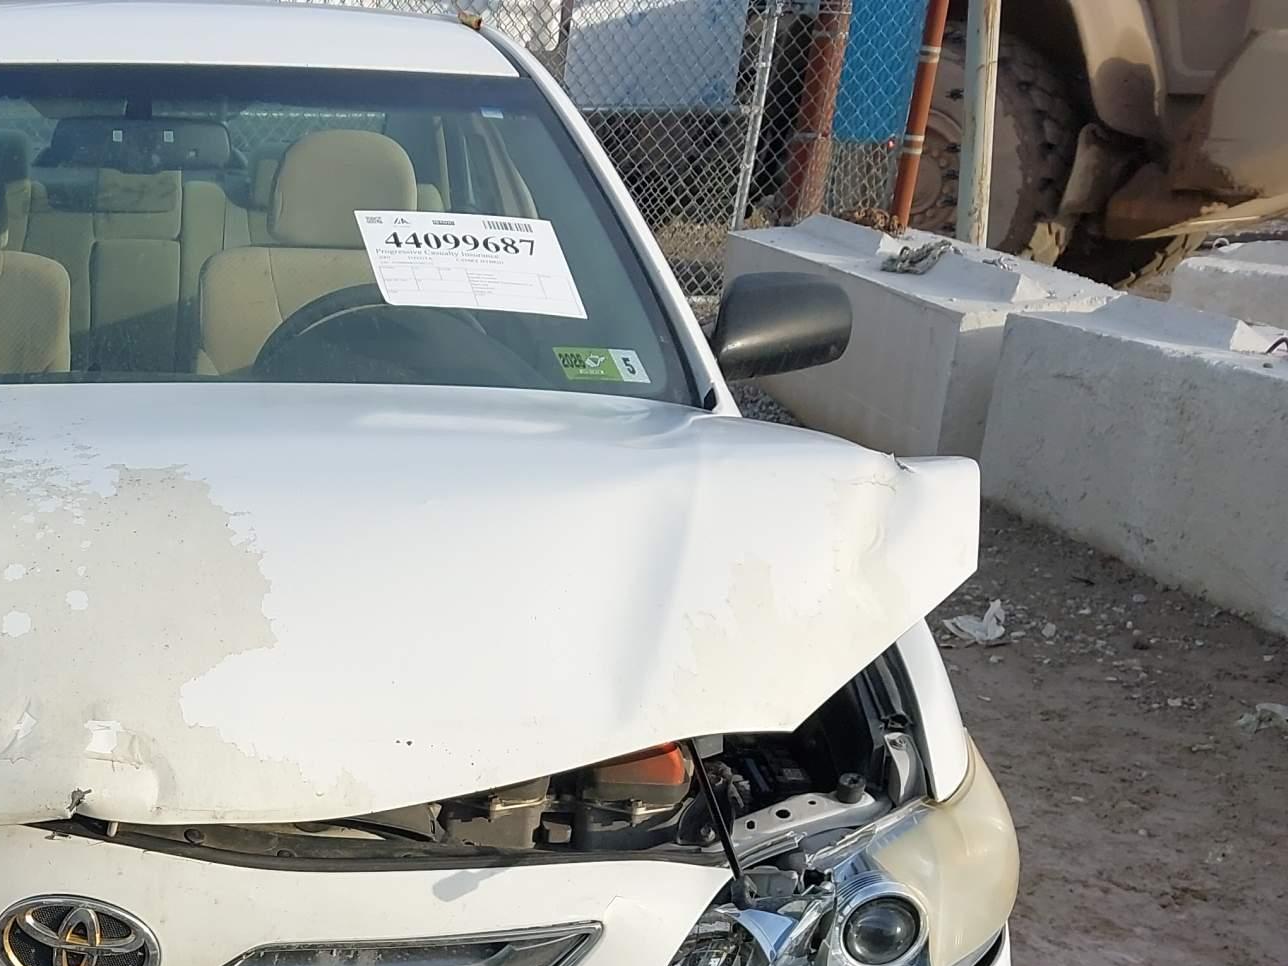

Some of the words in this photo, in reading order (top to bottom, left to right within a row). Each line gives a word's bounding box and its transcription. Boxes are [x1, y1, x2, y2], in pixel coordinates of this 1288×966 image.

[375, 248, 422, 256] Progressive
[424, 249, 458, 257] Casualty
[385, 231, 535, 256] 44099687
[621, 357, 636, 375] 5
